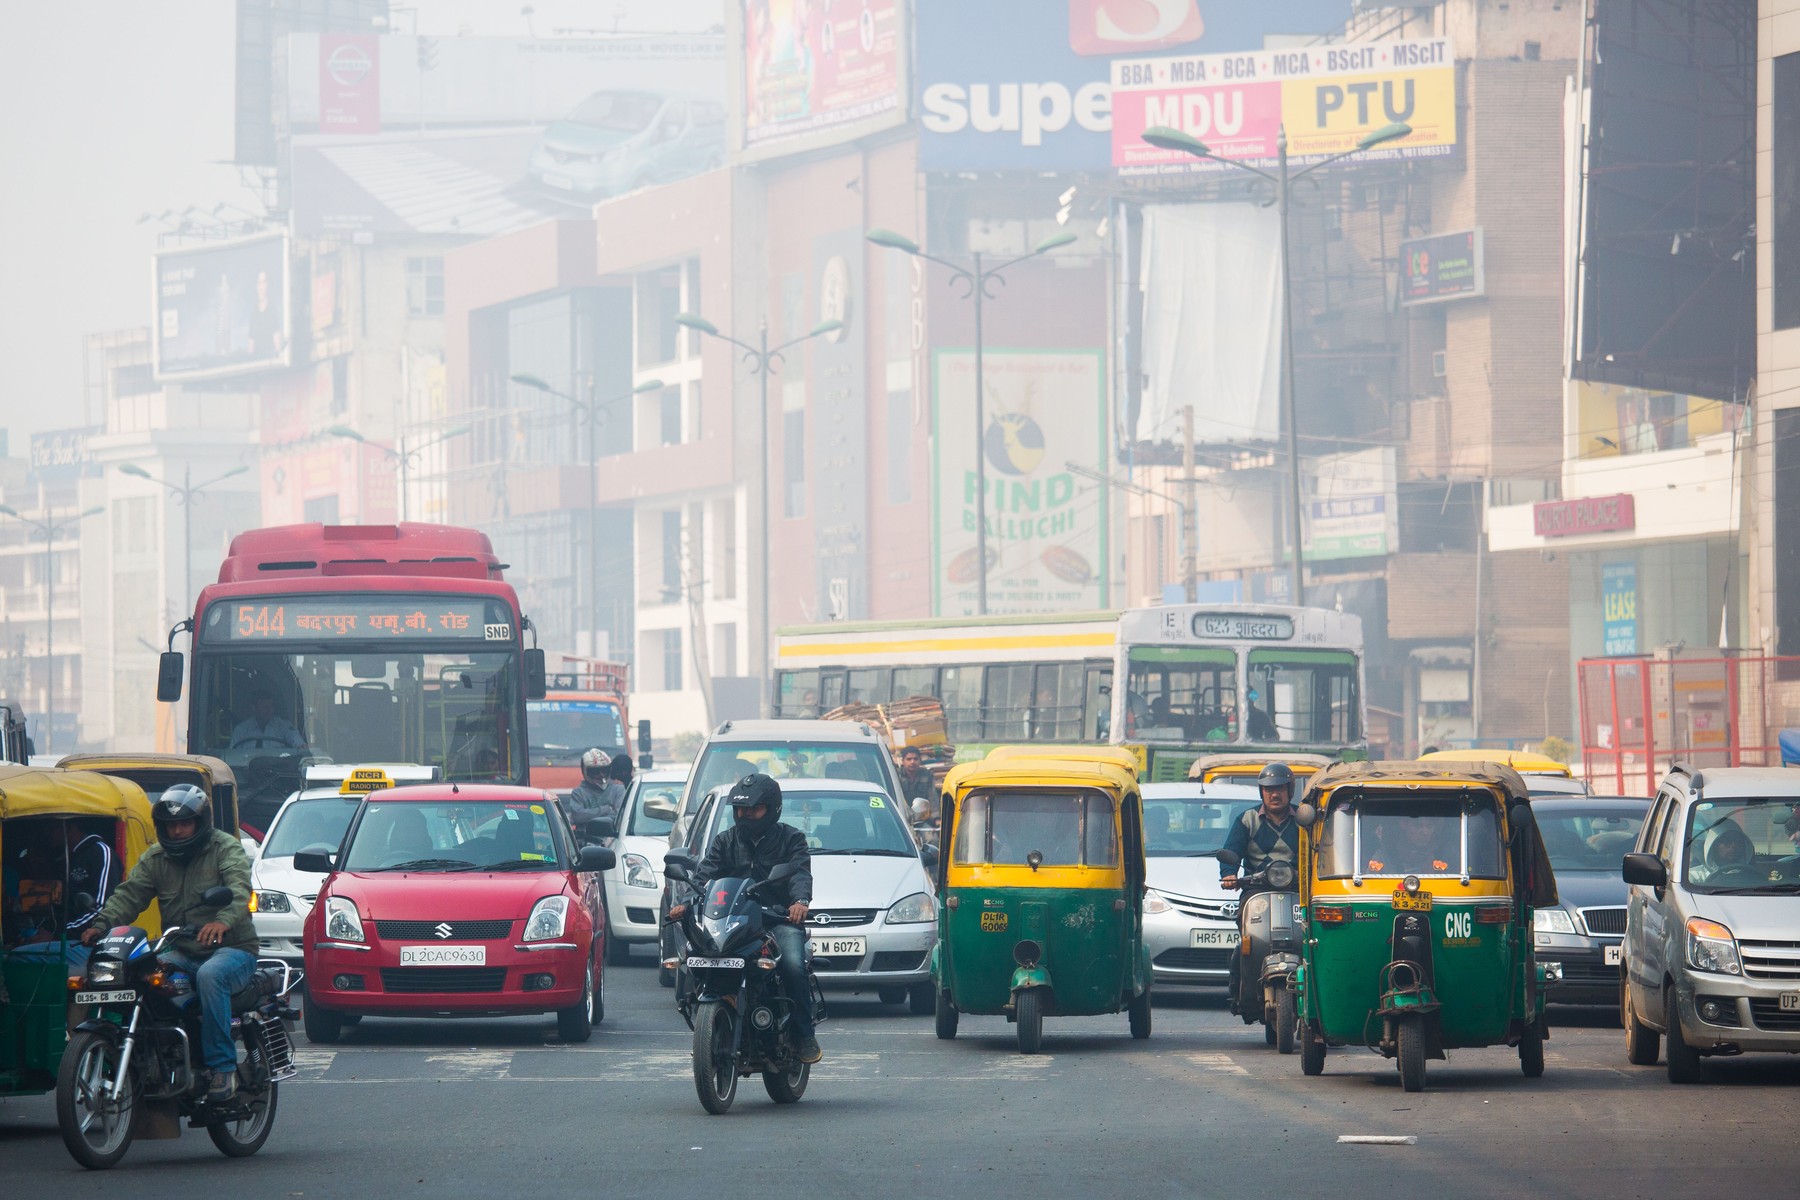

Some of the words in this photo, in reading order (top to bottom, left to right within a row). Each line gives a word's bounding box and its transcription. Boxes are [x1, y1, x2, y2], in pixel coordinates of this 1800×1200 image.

[1120, 63, 1153, 85] BBA
[1170, 60, 1206, 83] MBA
[1223, 57, 1256, 79] BCA
[1273, 53, 1310, 76] MCA
[1327, 47, 1375, 72] BScIT
[1393, 41, 1445, 67] MScIT
[1145, 91, 1243, 138] MDU
[1315, 79, 1415, 129] PTU
[1407, 247, 1429, 277] ice
[964, 470, 1075, 513] PIND
[1538, 504, 1573, 531] KURTA
[1576, 499, 1620, 528] PALACE
[1605, 591, 1635, 622] LEASE
[239, 606, 285, 637] 544
[486, 627, 510, 639] SND
[1205, 618, 1230, 635] 623
[1196, 933, 1221, 944] HR51
[1226, 933, 1240, 944] AR
[1445, 912, 1471, 938] CNG
[821, 942, 830, 953] M
[833, 941, 860, 953] 6072
[1612, 949, 1619, 960] H
[710, 959, 720, 967] SN
[1782, 995, 1798, 1008] UP
